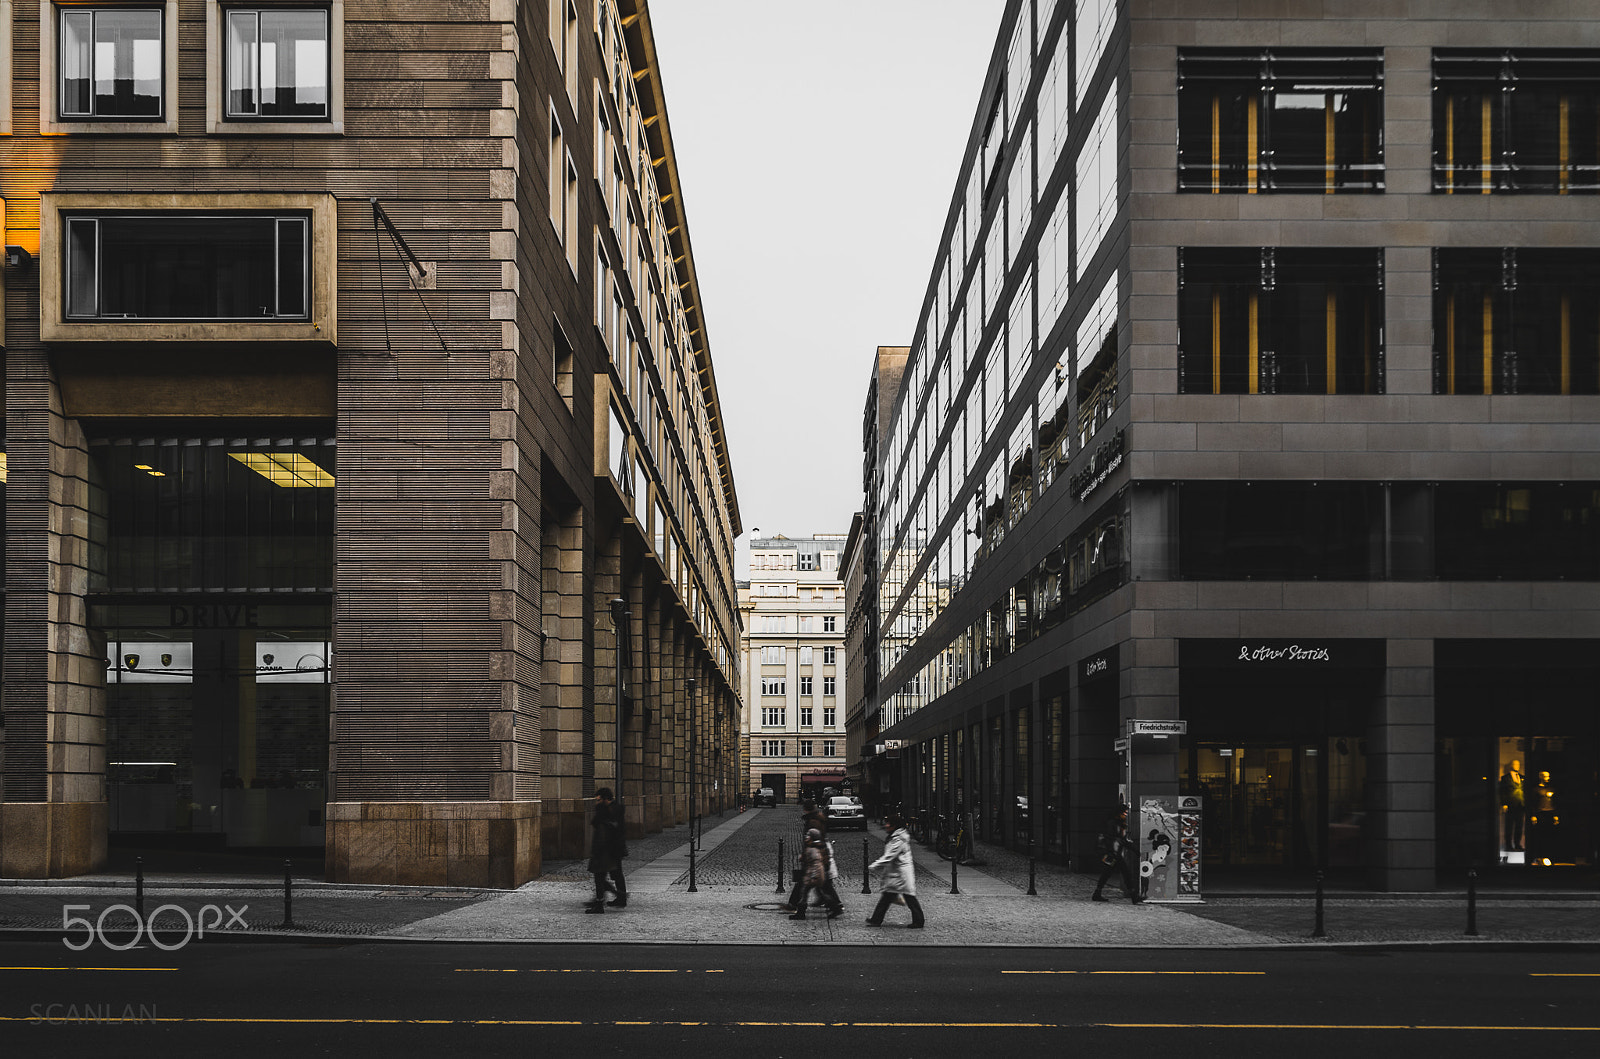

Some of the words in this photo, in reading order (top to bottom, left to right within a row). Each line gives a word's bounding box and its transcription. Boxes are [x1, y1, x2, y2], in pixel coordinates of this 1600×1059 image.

[170, 605, 258, 626] DRIVE
[1238, 645, 1251, 661] &
[1252, 645, 1288, 661] other
[1289, 645, 1329, 661] Stories
[1140, 723, 1180, 732] Friedrichstraße
